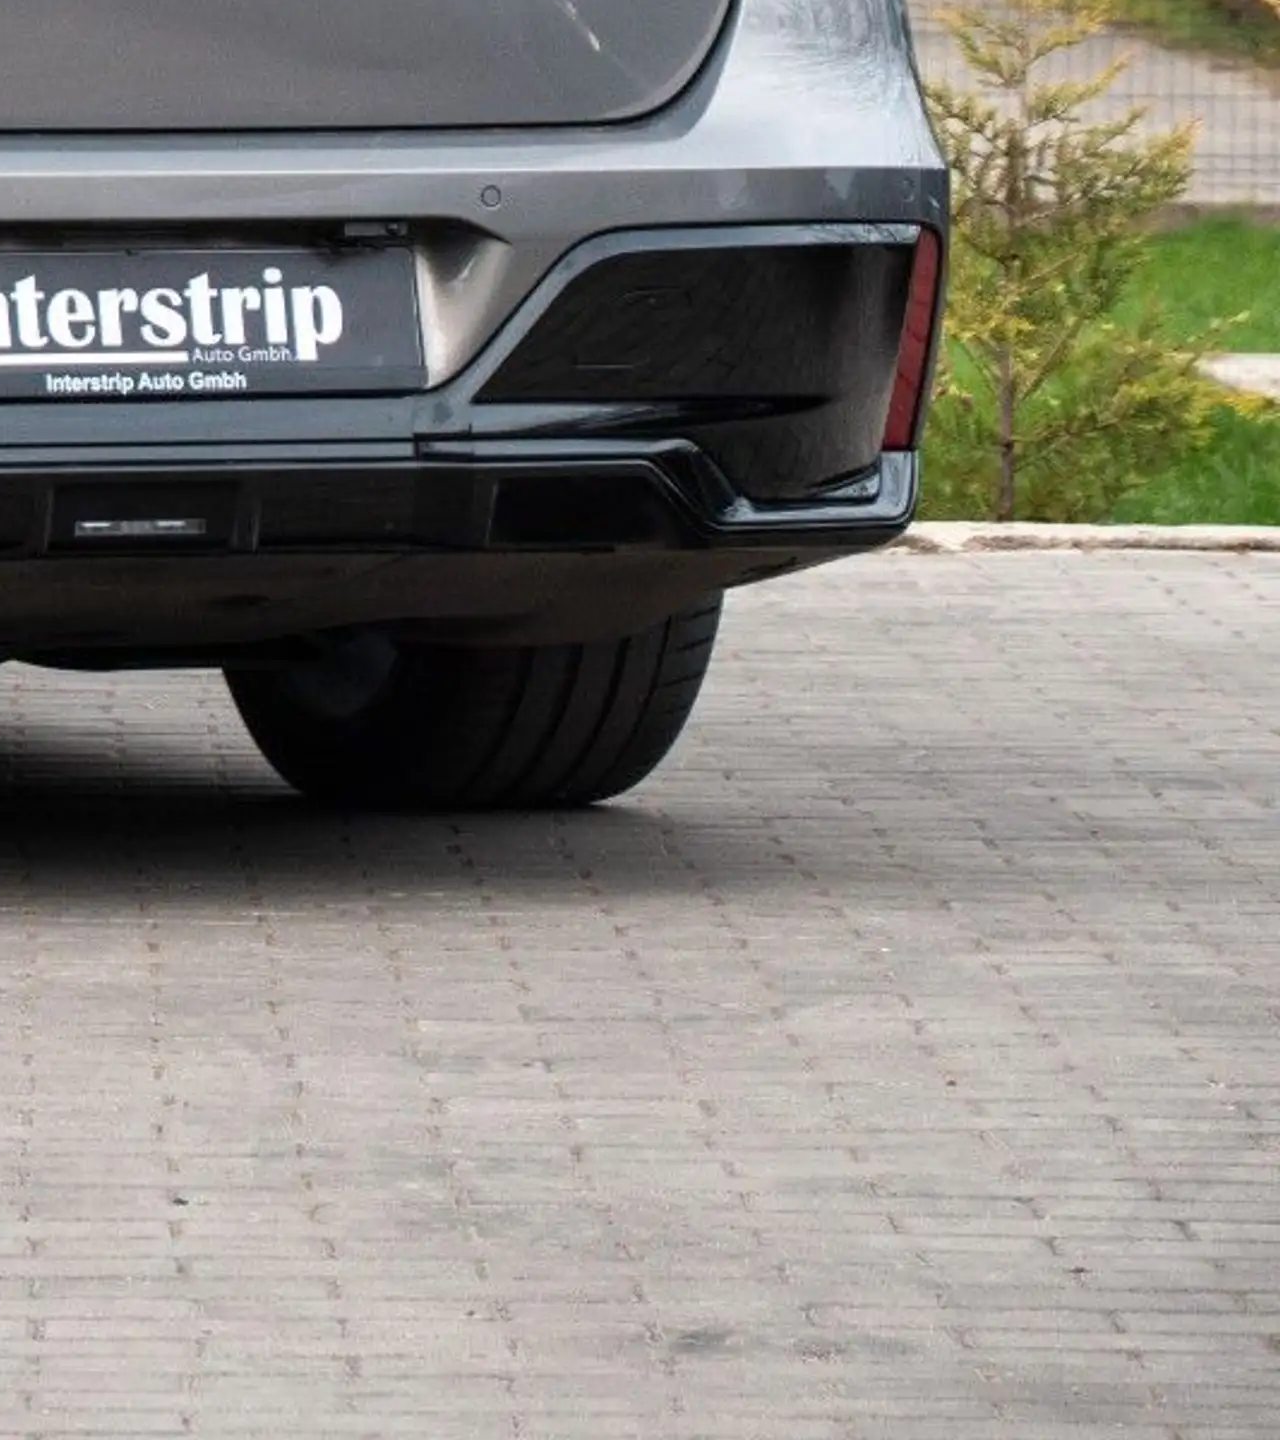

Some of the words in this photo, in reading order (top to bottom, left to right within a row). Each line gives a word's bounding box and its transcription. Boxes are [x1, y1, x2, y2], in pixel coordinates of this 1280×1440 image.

[192, 346, 235, 362] Auto
[46, 372, 134, 395] Interstrip
[138, 372, 185, 392] Auto
[189, 371, 248, 391] Gmbh
